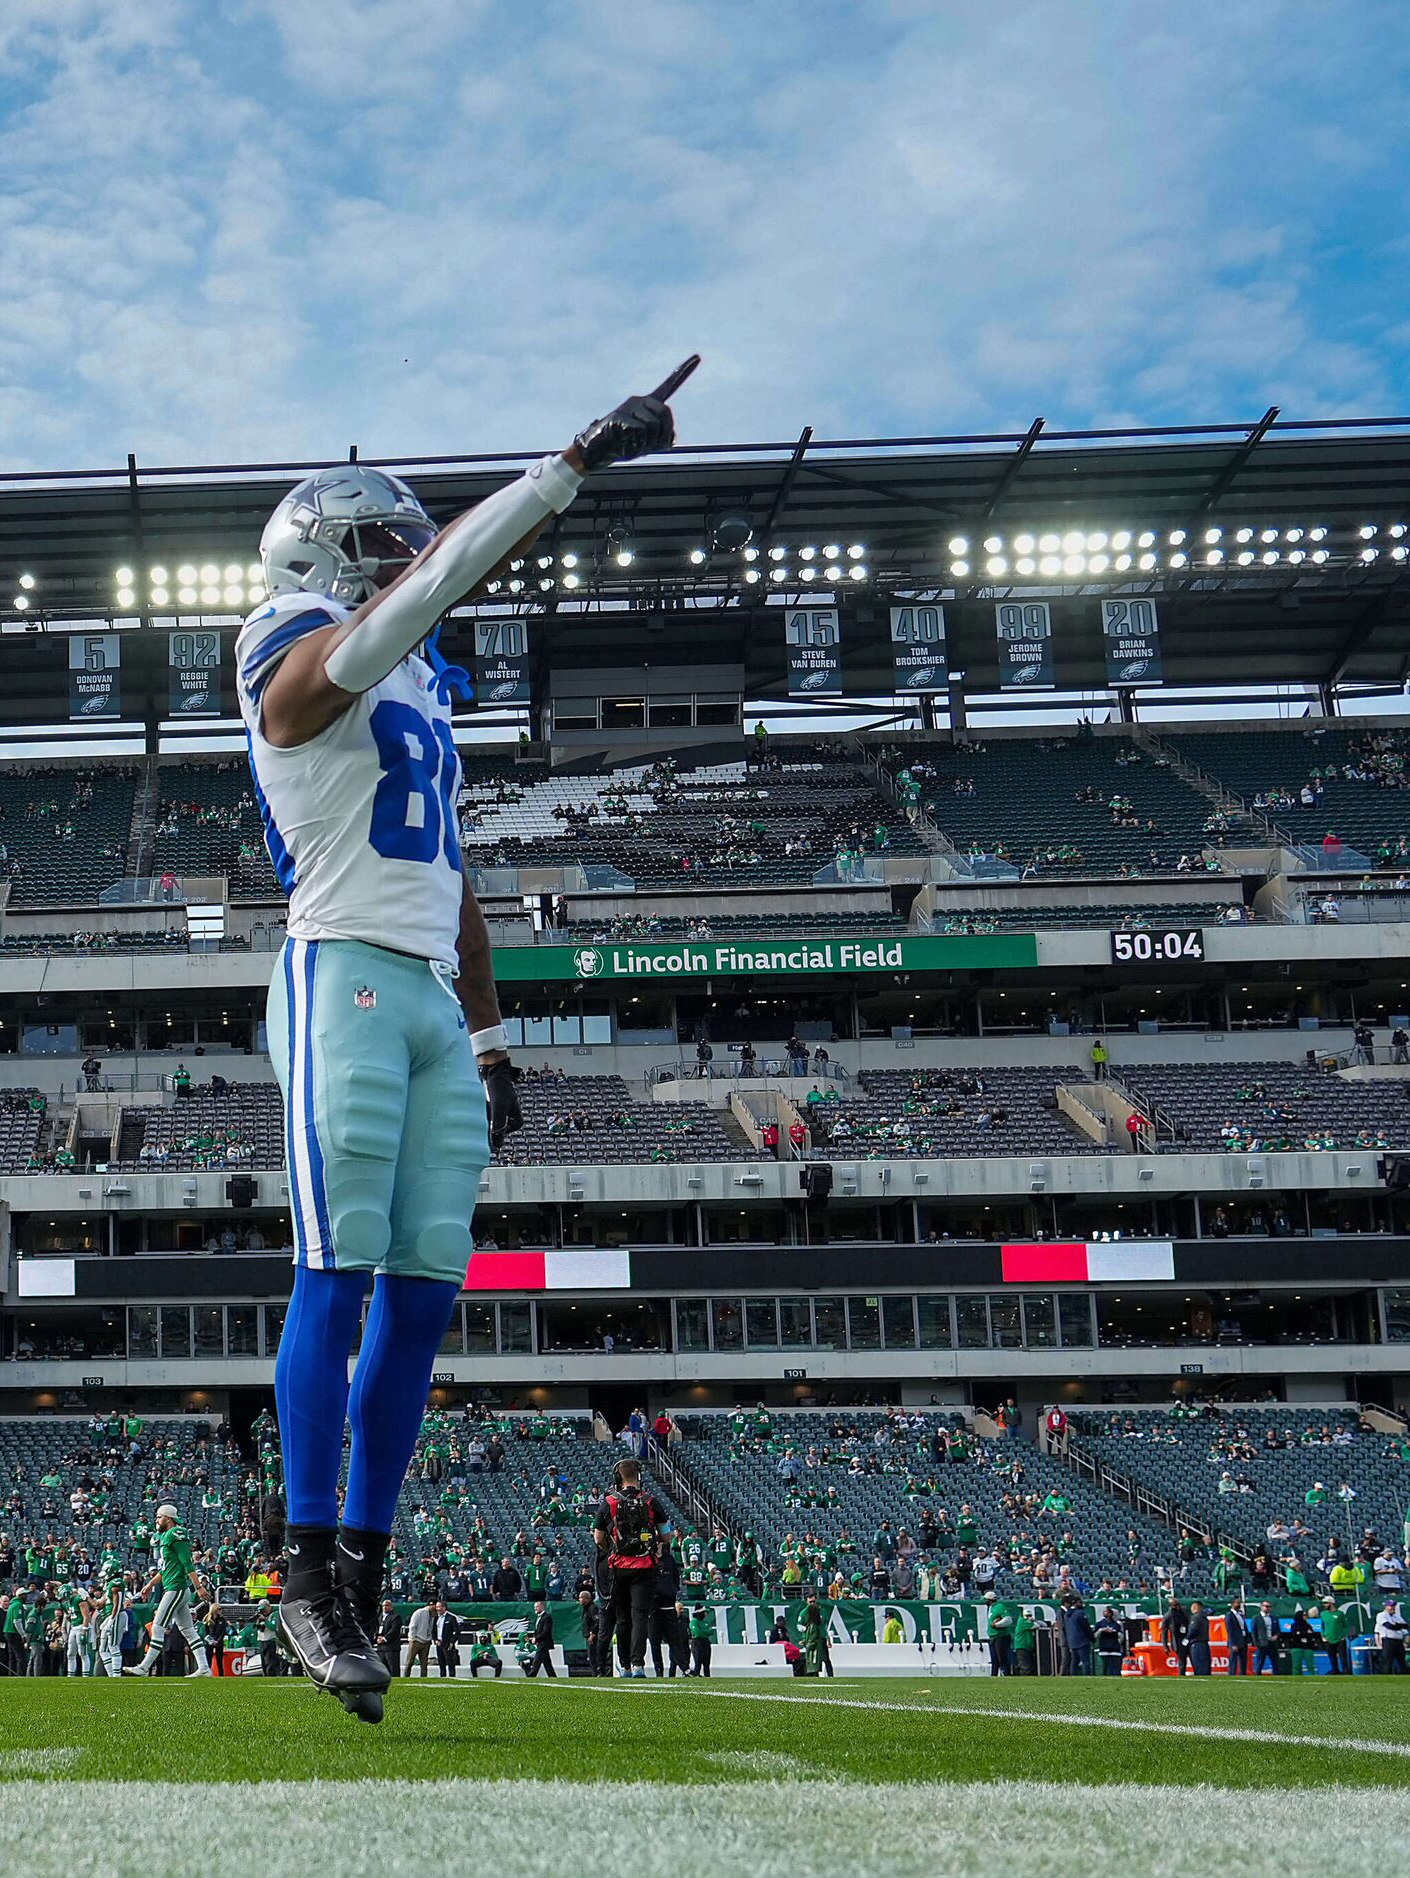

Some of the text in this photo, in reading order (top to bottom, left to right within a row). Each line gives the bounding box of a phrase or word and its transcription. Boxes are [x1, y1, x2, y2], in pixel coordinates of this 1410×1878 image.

[1001, 603, 1047, 641] 99
[1107, 599, 1152, 637] 20
[789, 611, 835, 647] 15
[897, 605, 944, 645] 40
[479, 622, 528, 657] 70
[1119, 639, 1146, 649] BRIAN
[84, 637, 107, 670] 5
[173, 633, 217, 669] 92
[910, 648, 928, 657] TOM
[1008, 644, 1043, 654] JEROME
[1113, 648, 1154, 659] DAWKINS
[801, 651, 826, 660] STEVE
[895, 655, 945, 666] BROOKSHIER
[1009, 653, 1042, 662] BROWN
[497, 661, 508, 670] AL
[791, 659, 837, 669] VAN BUREN
[180, 672, 210, 682] REGGIE
[485, 669, 521, 679] WISTERT
[76, 675, 113, 684] DONOVAN
[78, 684, 111, 693] McNABB
[182, 681, 209, 690] WHITE
[1114, 931, 1202, 961] 50:04
[613, 942, 903, 974] Lincoln Financial Field
[786, 1369, 805, 1379] 101
[1182, 1364, 1204, 1374] 138
[83, 1377, 102, 1386] 103
[434, 1372, 452, 1382] 102
[735, 1415, 744, 1424] 12
[558, 1502, 566, 1512] 11
[688, 1544, 700, 1554] 26
[715, 1542, 726, 1552] 12
[389, 1550, 396, 1560] 6
[56, 1564, 68, 1574] 65
[78, 1564, 89, 1574] 20
[534, 1570, 540, 1580] 1
[690, 1572, 702, 1582] 88
[477, 1578, 488, 1588] 11
[232, 1657, 242, 1676] G
